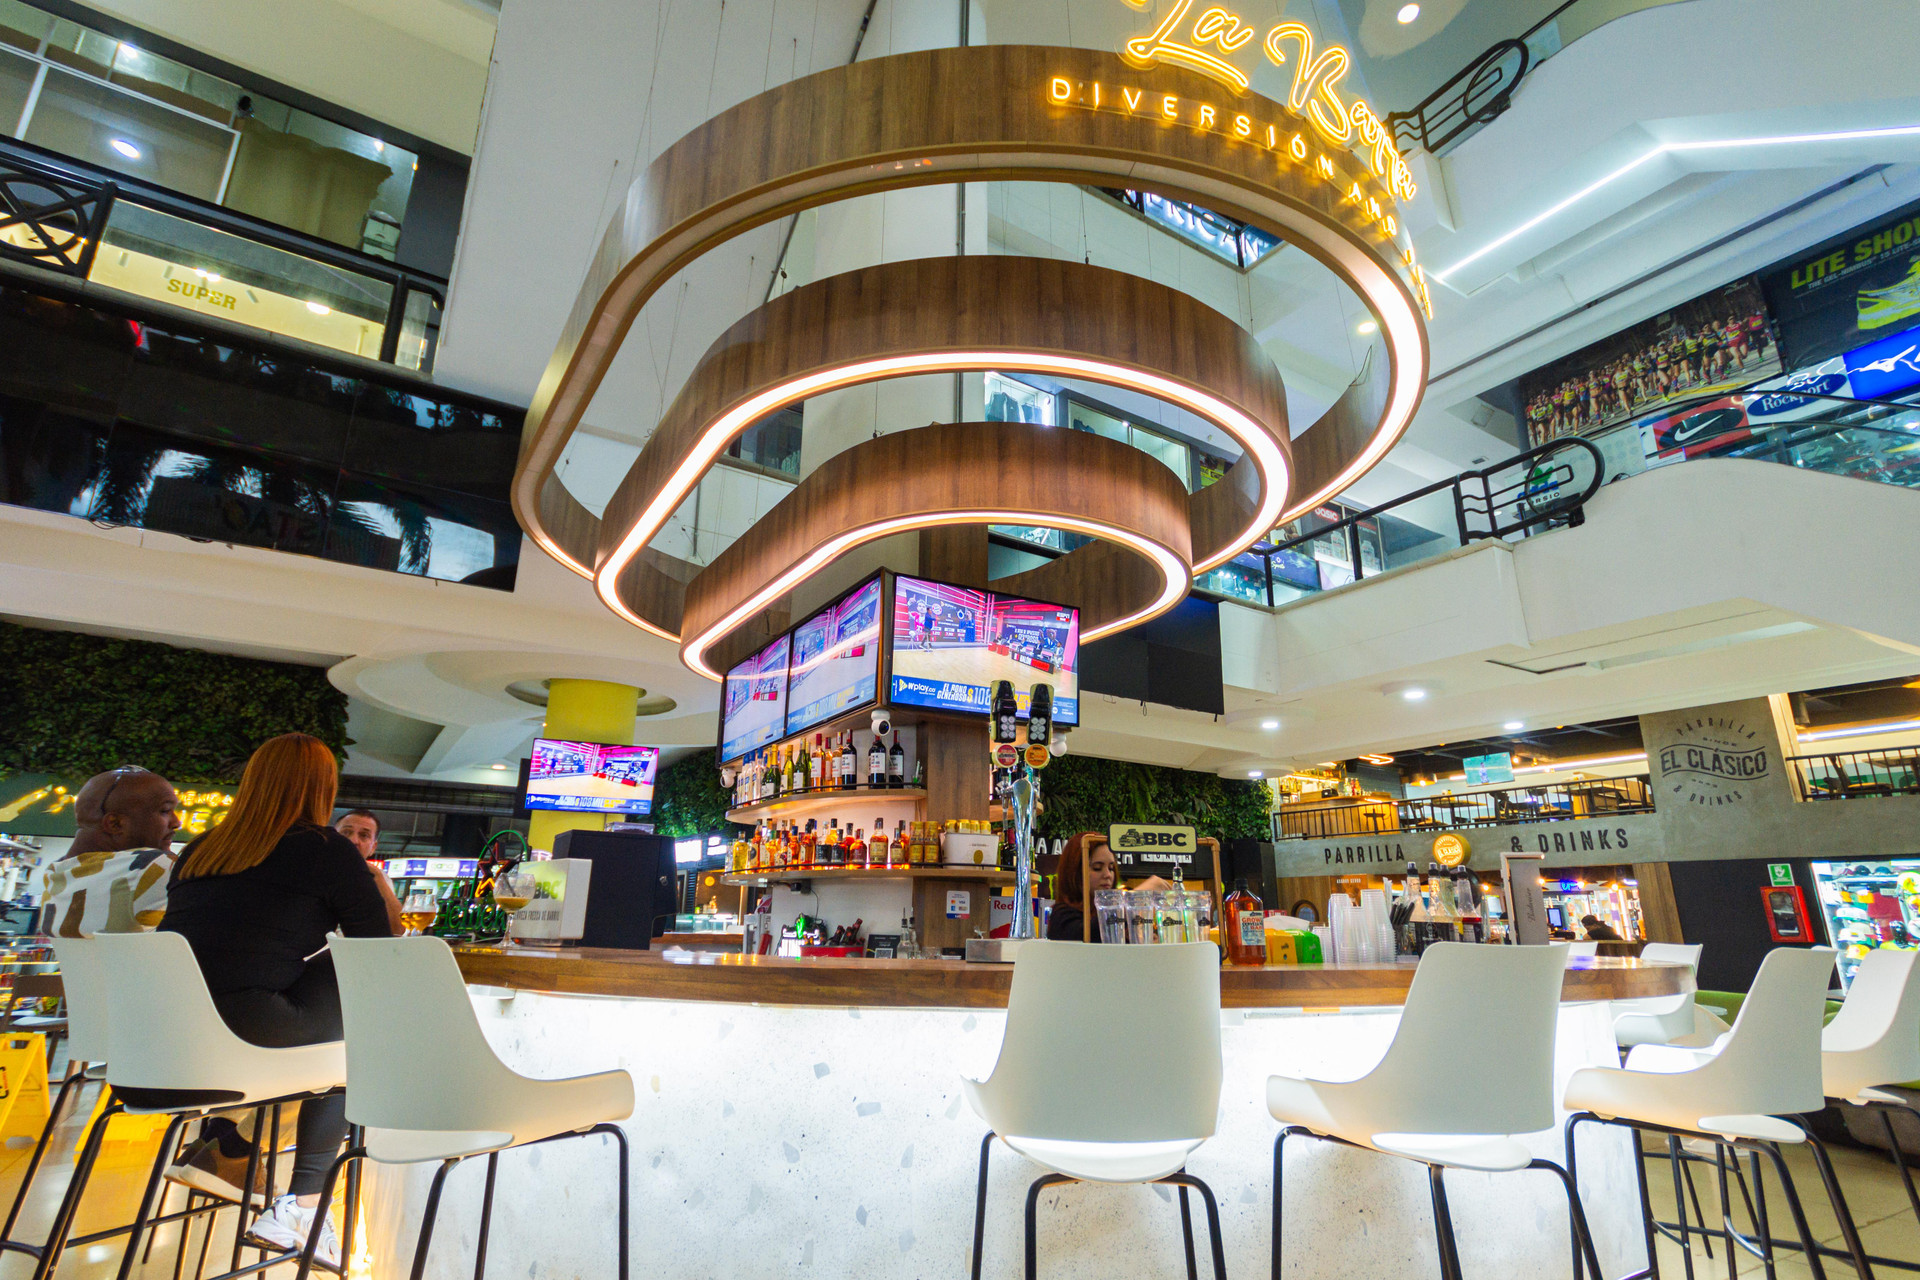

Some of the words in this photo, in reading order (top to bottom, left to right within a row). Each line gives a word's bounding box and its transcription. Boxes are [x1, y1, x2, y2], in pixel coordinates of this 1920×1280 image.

[1791, 249, 1846, 290] LITE
[167, 278, 237, 311] SUPER
[1676, 717, 1756, 739] PARRILLA
[1661, 749, 1682, 772] EL
[1689, 790, 1742, 806] DRINKS
[1143, 832, 1187, 847] BBC
[1324, 844, 1405, 864] PARRILLA
[1511, 836, 1523, 852] &
[1538, 828, 1628, 853] DRINKS
[435, 899, 506, 931] Heinek
[994, 900, 1014, 911] Red
